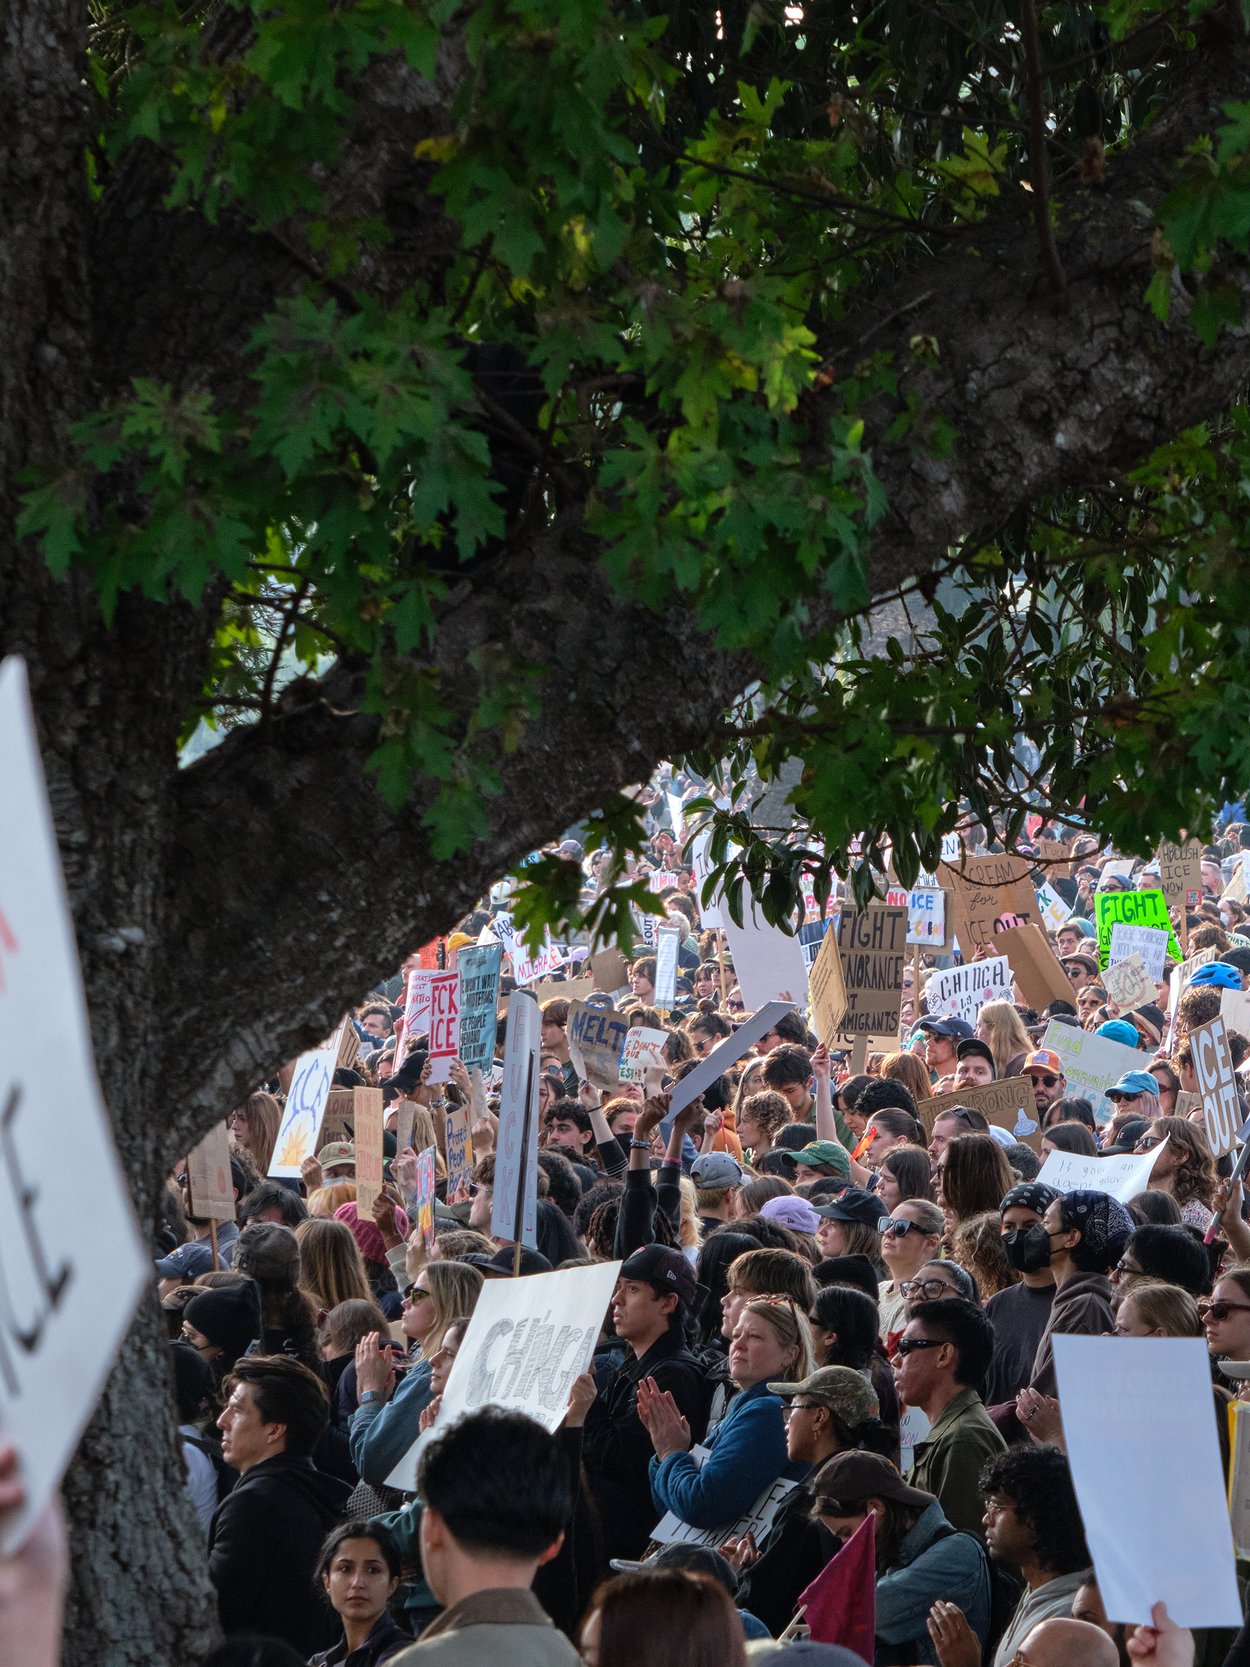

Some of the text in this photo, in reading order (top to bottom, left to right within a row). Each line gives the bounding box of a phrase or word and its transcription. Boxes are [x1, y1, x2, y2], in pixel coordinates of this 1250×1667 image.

[1044, 843, 1065, 858] FUCK
[1163, 846, 1199, 863] ABOLISH
[966, 861, 1017, 892] SCREAM
[1164, 864, 1190, 880] ICE
[1161, 882, 1184, 895] NOW
[888, 892, 907, 906] NO
[912, 894, 934, 910] ICE
[970, 892, 998, 910] for
[1100, 894, 1158, 926] FIGHT
[644, 918, 653, 938] OUT
[838, 910, 904, 950] FIGHT
[964, 920, 991, 946] ICE
[518, 954, 548, 982] MIGRA
[482, 974, 496, 990] WAIT
[940, 961, 1005, 1002] CHINGA
[412, 993, 430, 1004] NATIO
[432, 982, 458, 1016] FCK
[468, 1014, 486, 1030] PEOPLE
[571, 1010, 628, 1052] MELT
[430, 1017, 456, 1050] ICE
[1048, 1024, 1086, 1054] Fund
[464, 1046, 472, 1060] OUT
[633, 1040, 660, 1052] DON'T
[1190, 1020, 1234, 1096] ICE
[1203, 1084, 1244, 1156] OUT
[1060, 1160, 1072, 1173] If
